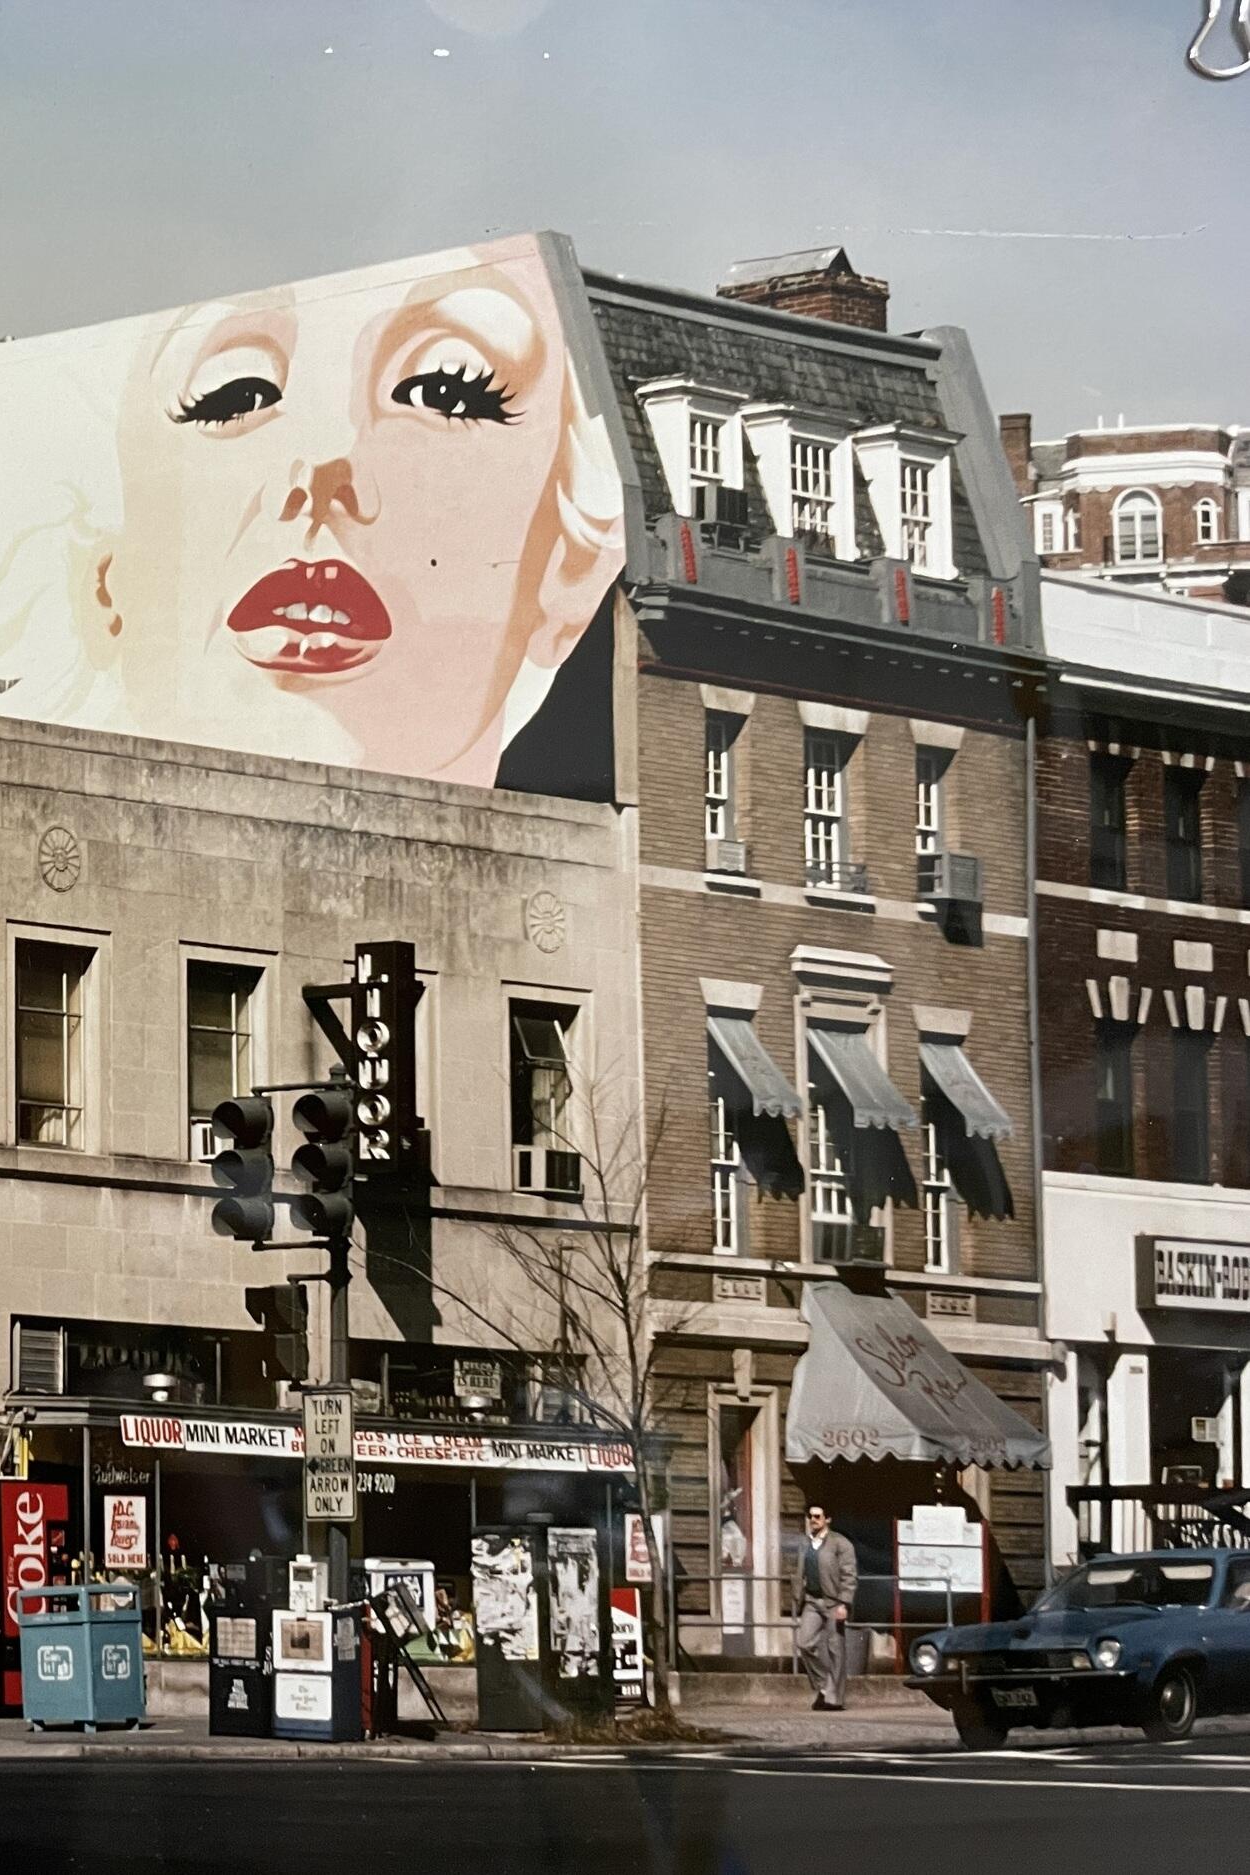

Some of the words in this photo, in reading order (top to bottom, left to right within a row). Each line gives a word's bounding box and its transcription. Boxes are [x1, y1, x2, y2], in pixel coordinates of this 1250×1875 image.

[357, 953, 391, 1160] LIQUOR
[311, 1399, 342, 1415] TURN
[122, 1417, 183, 1447] LIQUOR
[315, 1419, 340, 1434] LEFT
[186, 1424, 220, 1444] MINI
[224, 1426, 286, 1448] MARKET
[353, 1430, 385, 1443] GGS
[396, 1433, 422, 1445] ICE
[432, 1435, 484, 1448] CREAM
[320, 1438, 336, 1453] ON
[357, 1444, 387, 1457] EER
[397, 1447, 452, 1460] CHEESE
[491, 1440, 522, 1458] MINI
[525, 1444, 585, 1463] MARKET
[588, 1444, 637, 1468] LIQUO
[320, 1458, 351, 1474] GREEN
[310, 1477, 350, 1493] ARROW
[374, 1473, 395, 1493] 9200
[315, 1497, 343, 1512] ONLY
[7, 1491, 47, 1625] Coke
[108, 1554, 125, 1564] SOLD
[127, 1553, 144, 1564] HERE
